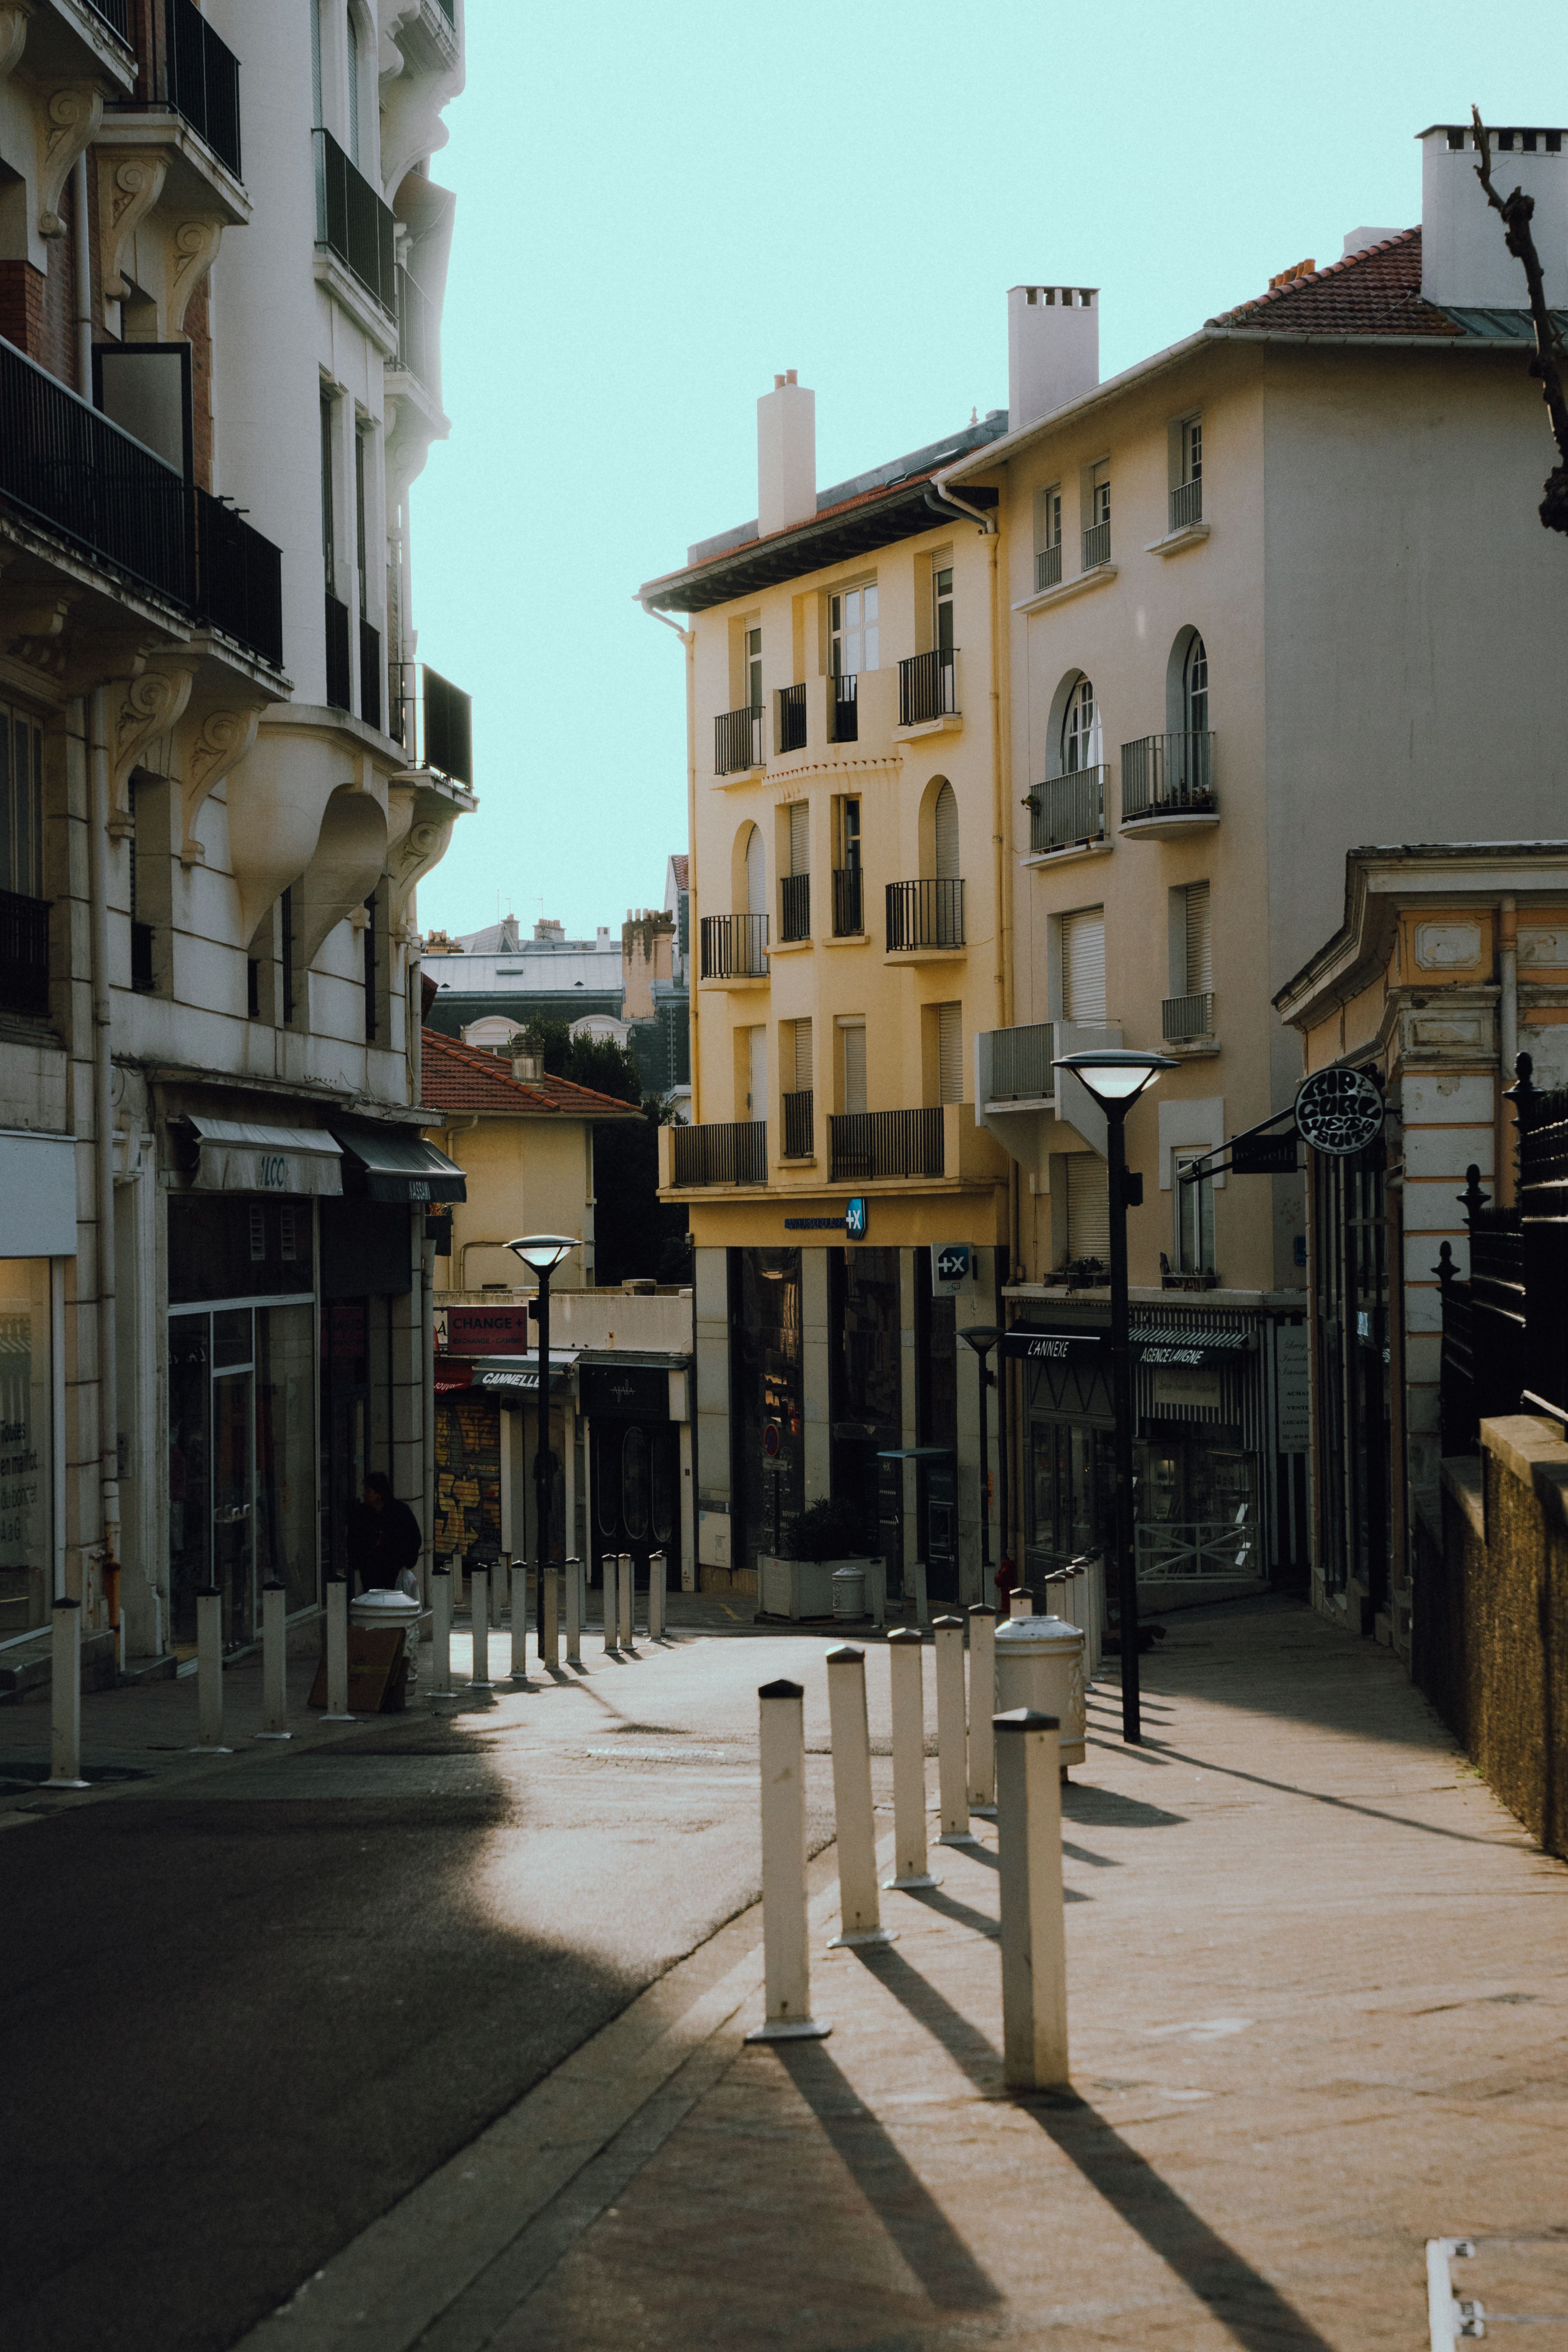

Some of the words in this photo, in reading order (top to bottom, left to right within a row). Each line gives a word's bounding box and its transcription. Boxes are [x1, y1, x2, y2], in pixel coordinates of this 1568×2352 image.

[1302, 1070, 1357, 1100] RIP
[1299, 1094, 1381, 1121] CURL
[1301, 1116, 1362, 1135] WET
[1314, 1120, 1375, 1147] SUITS
[785, 1218, 810, 1228] BANQUE
[810, 1218, 846, 1228] POPULAIRE
[453, 1317, 512, 1329] CHANGE
[1027, 1340, 1069, 1357] L'ANNEXE
[1140, 1347, 1172, 1363] AGENCE
[1168, 1349, 1204, 1364] LAVIGNE
